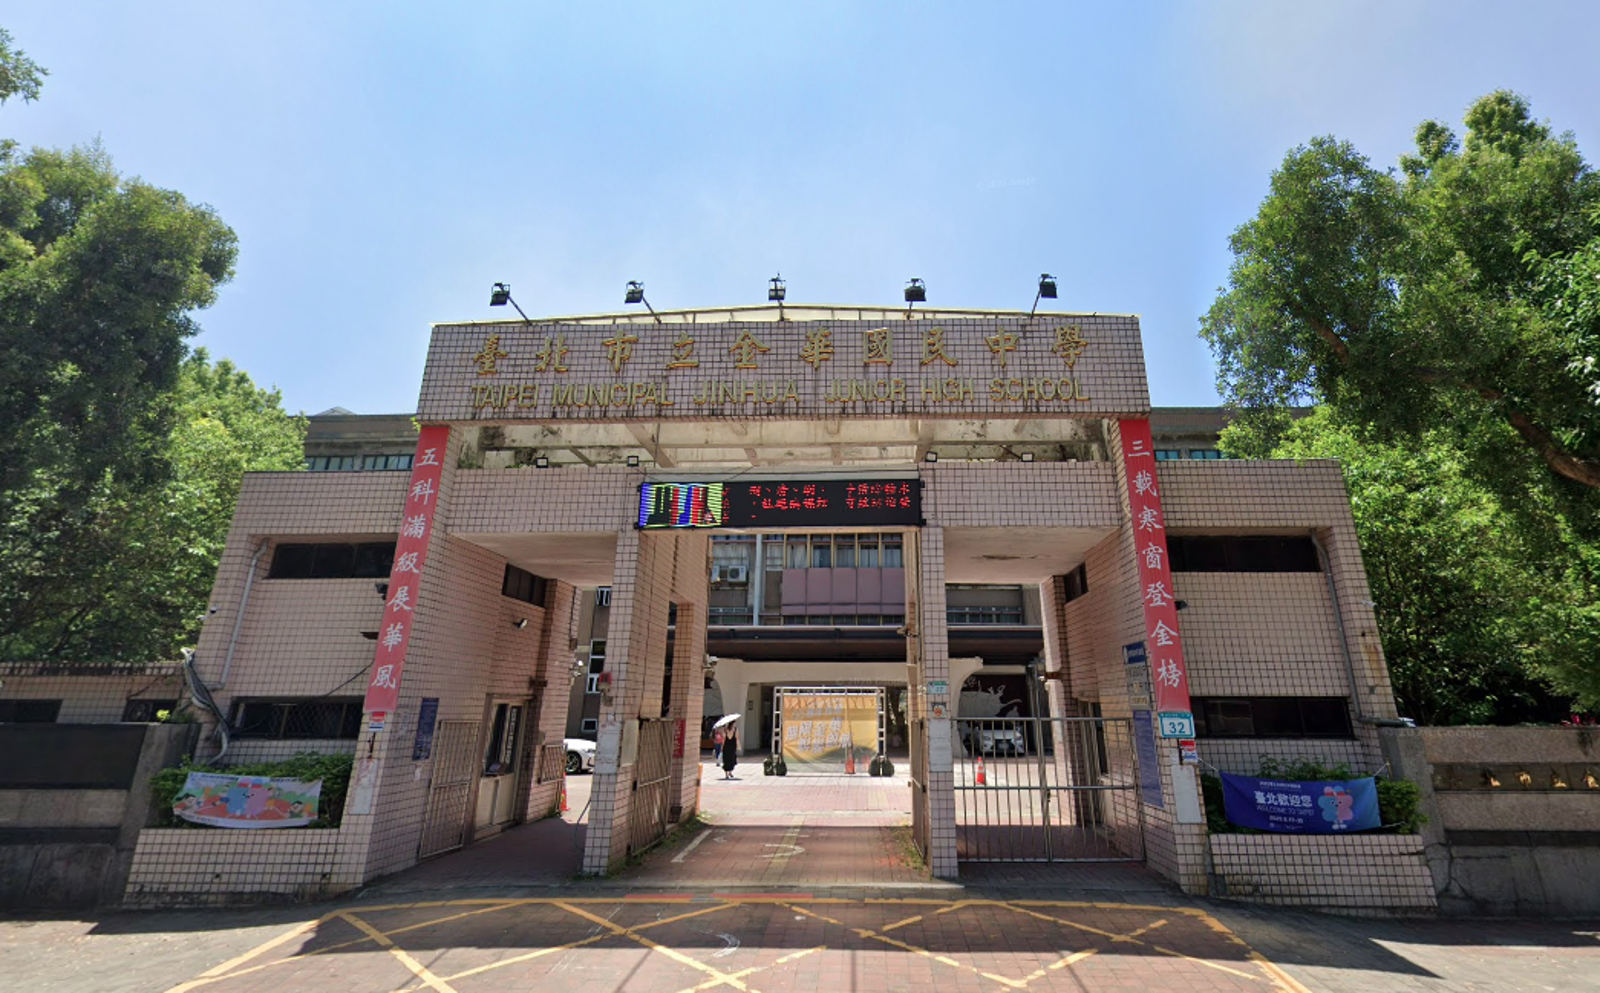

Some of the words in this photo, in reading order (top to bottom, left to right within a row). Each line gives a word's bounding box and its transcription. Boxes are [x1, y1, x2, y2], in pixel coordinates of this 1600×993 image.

[472, 323, 1089, 376] 臺北市立金華國民中學
[471, 383, 538, 409] TAIPEI
[552, 381, 674, 408] MUNICIPAL
[693, 379, 801, 405] JINHUA
[824, 378, 907, 403] JUNIOR
[921, 378, 974, 402] HIGH
[989, 377, 1091, 402] SCHOOL
[371, 447, 440, 690] 五科滿級展華風
[1127, 439, 1183, 689] 三載寒窗登金榜
[1169, 721, 1186, 734] 32
